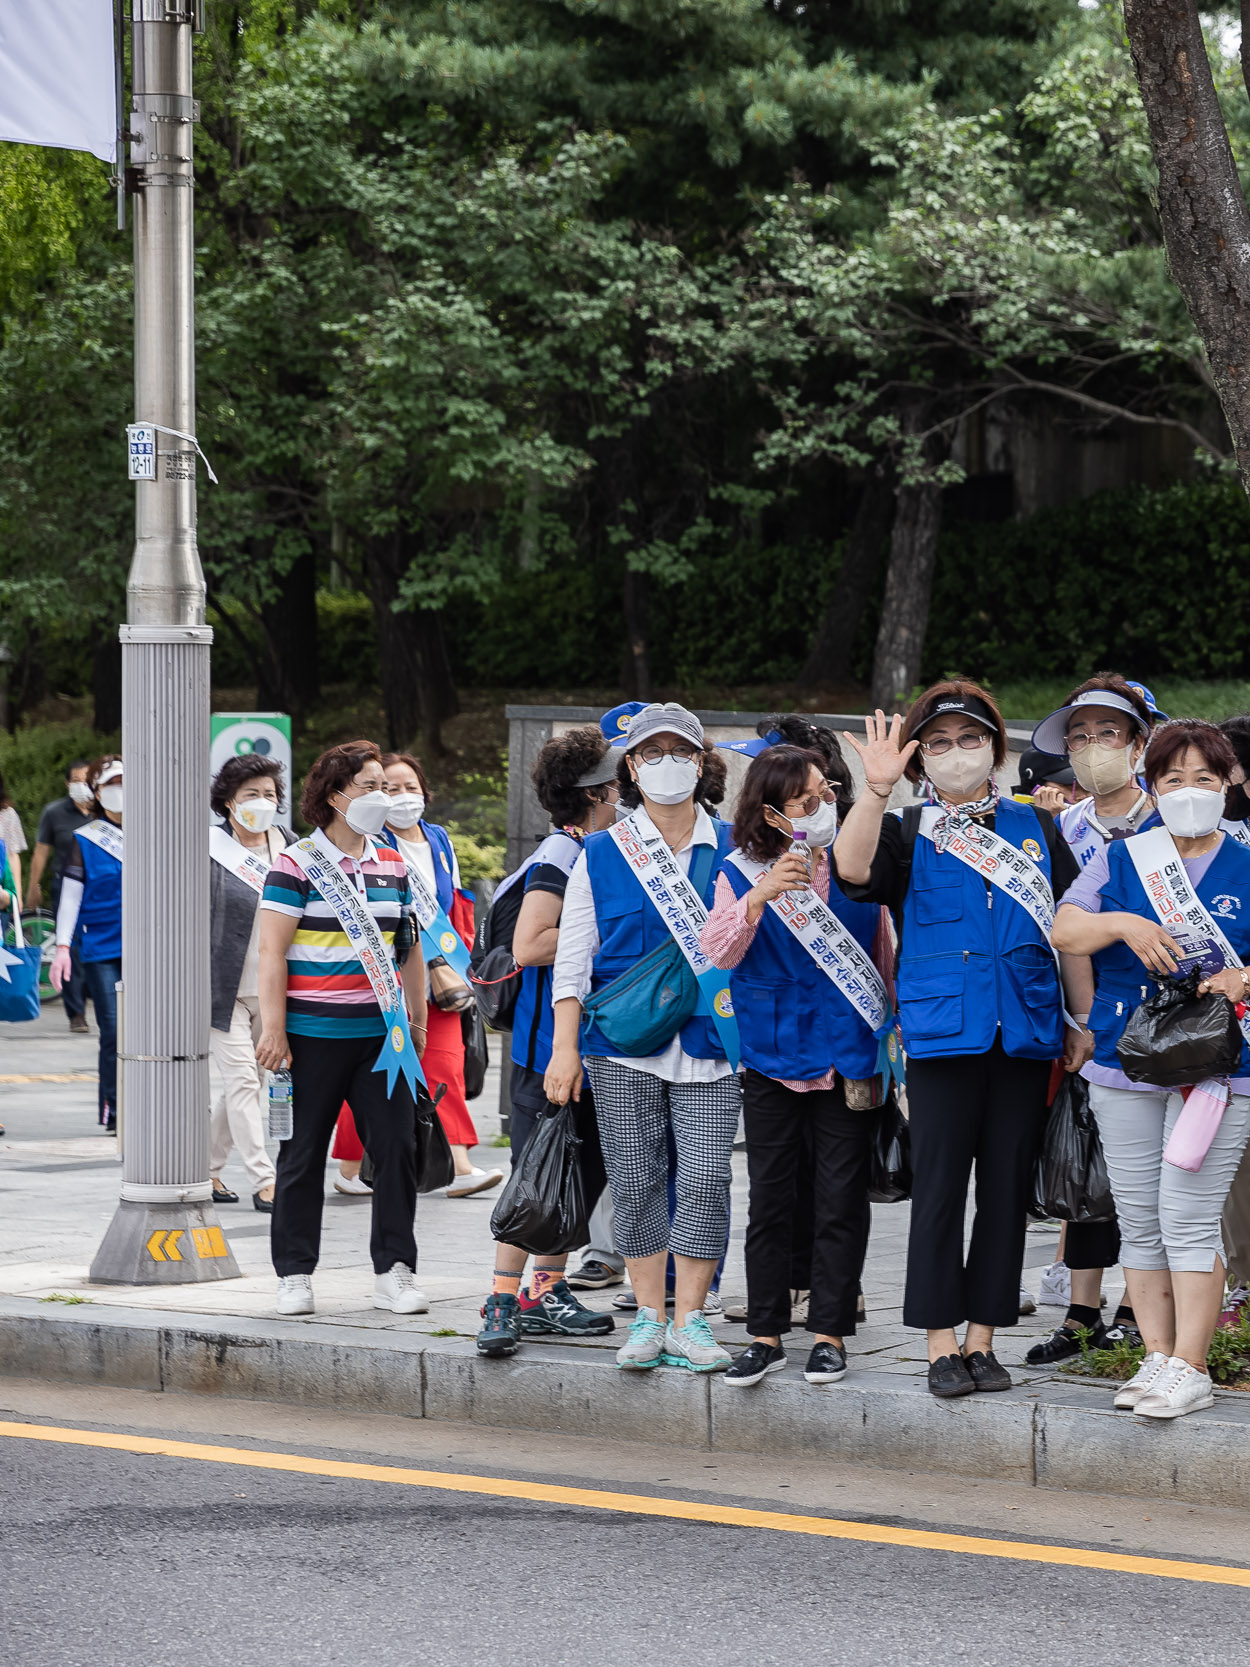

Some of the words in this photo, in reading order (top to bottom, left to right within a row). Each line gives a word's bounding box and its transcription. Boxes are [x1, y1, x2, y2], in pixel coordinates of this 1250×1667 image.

[131, 456, 152, 475] 12-11
[613, 821, 650, 869] 코로나19
[650, 847, 677, 878] 행락
[948, 833, 999, 874] 로나19
[996, 846, 1031, 875] 행락
[305, 863, 363, 941] 마스크착용
[1164, 861, 1191, 905] 여름철
[1185, 906, 1216, 937] 행락
[807, 905, 841, 937] 행락
